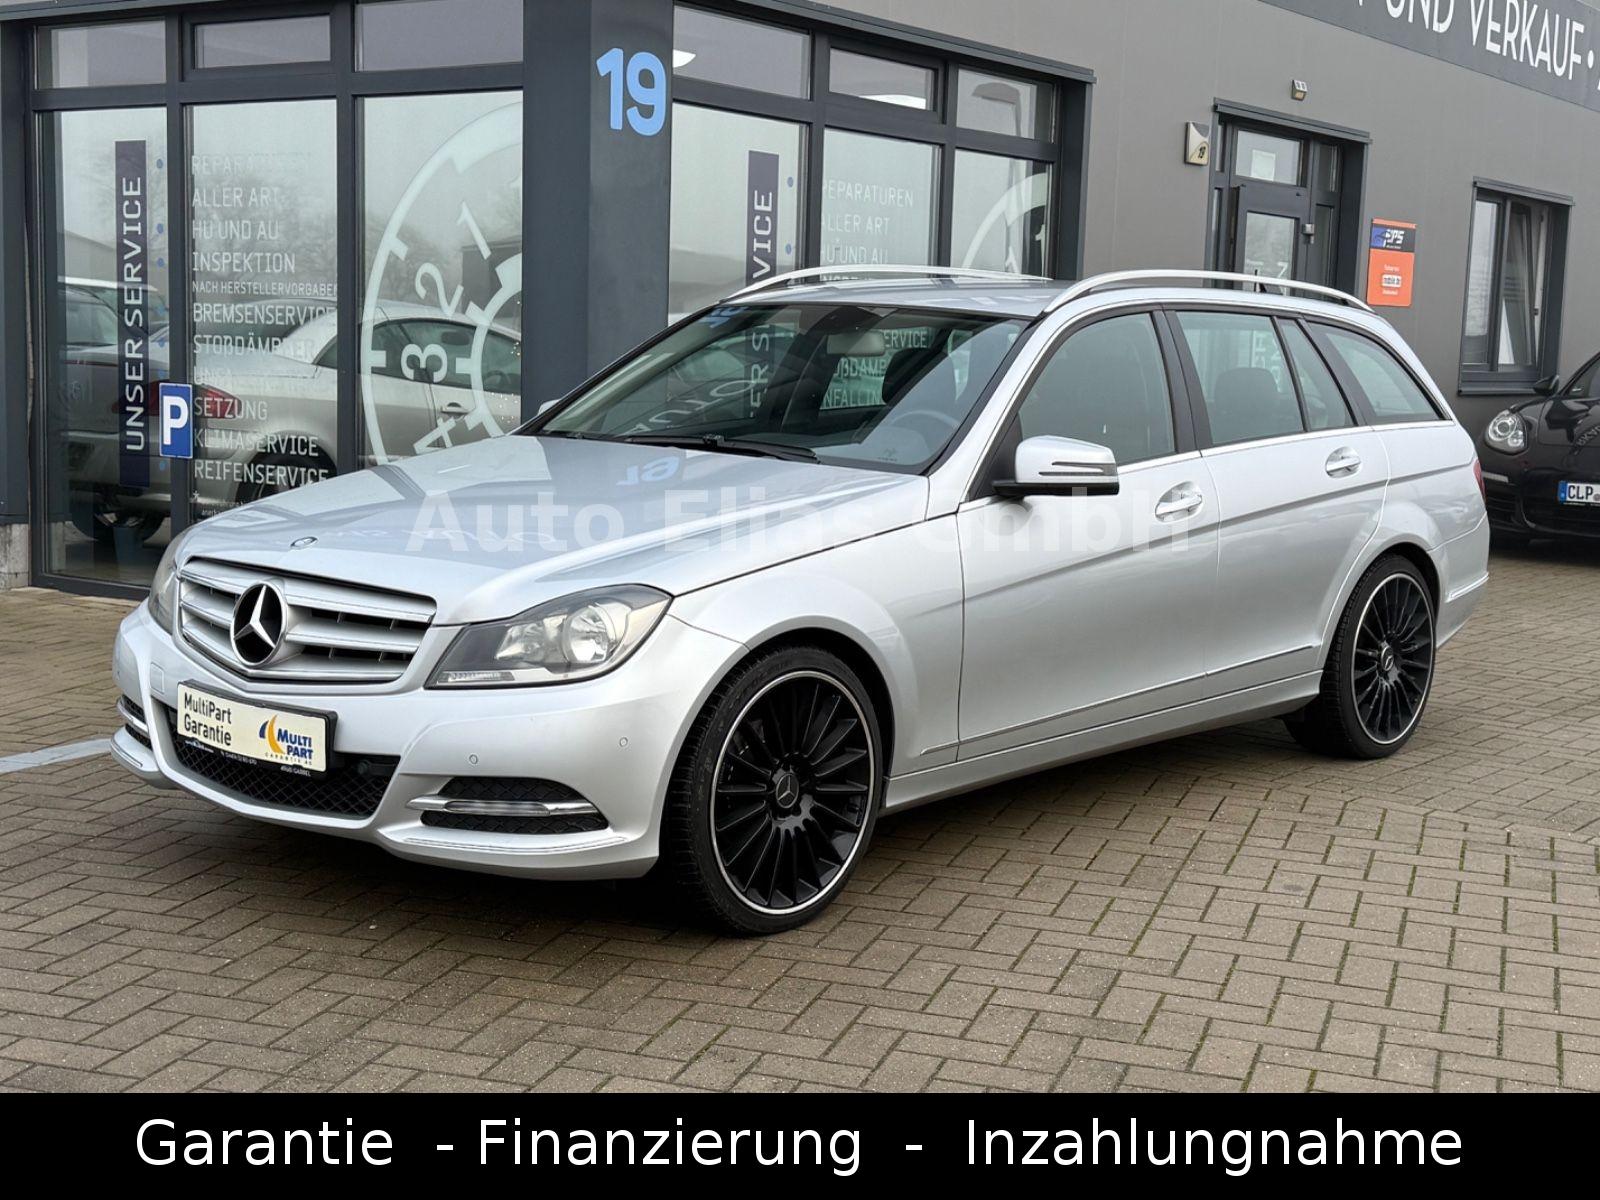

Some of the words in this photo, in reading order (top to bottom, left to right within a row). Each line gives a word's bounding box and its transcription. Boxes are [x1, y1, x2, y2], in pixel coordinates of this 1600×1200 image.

[1470, 0, 1584, 80] VERKAUF
[597, 48, 667, 136] 19
[192, 187, 243, 208] ALLER
[248, 187, 282, 208] ART
[192, 219, 213, 240] HU
[218, 219, 251, 240] UND
[256, 220, 279, 240] AU
[456, 201, 491, 260] 1
[122, 177, 143, 328] SERVICE
[193, 252, 295, 273] INSPEKTION
[192, 281, 218, 293] NACH
[414, 262, 465, 316] 2
[401, 343, 449, 384] 3
[125, 338, 145, 450] UNSER
[193, 397, 269, 421] SETZUNG
[162, 395, 189, 445] P
[412, 416, 458, 454] 4
[193, 428, 320, 457] KLIMASERVICE
[194, 460, 329, 487] REIFENSERVICE
[1567, 484, 1594, 500] CLP
[184, 692, 232, 725] MultiPart
[184, 713, 232, 746] Garantie
[286, 744, 313, 760] PART
